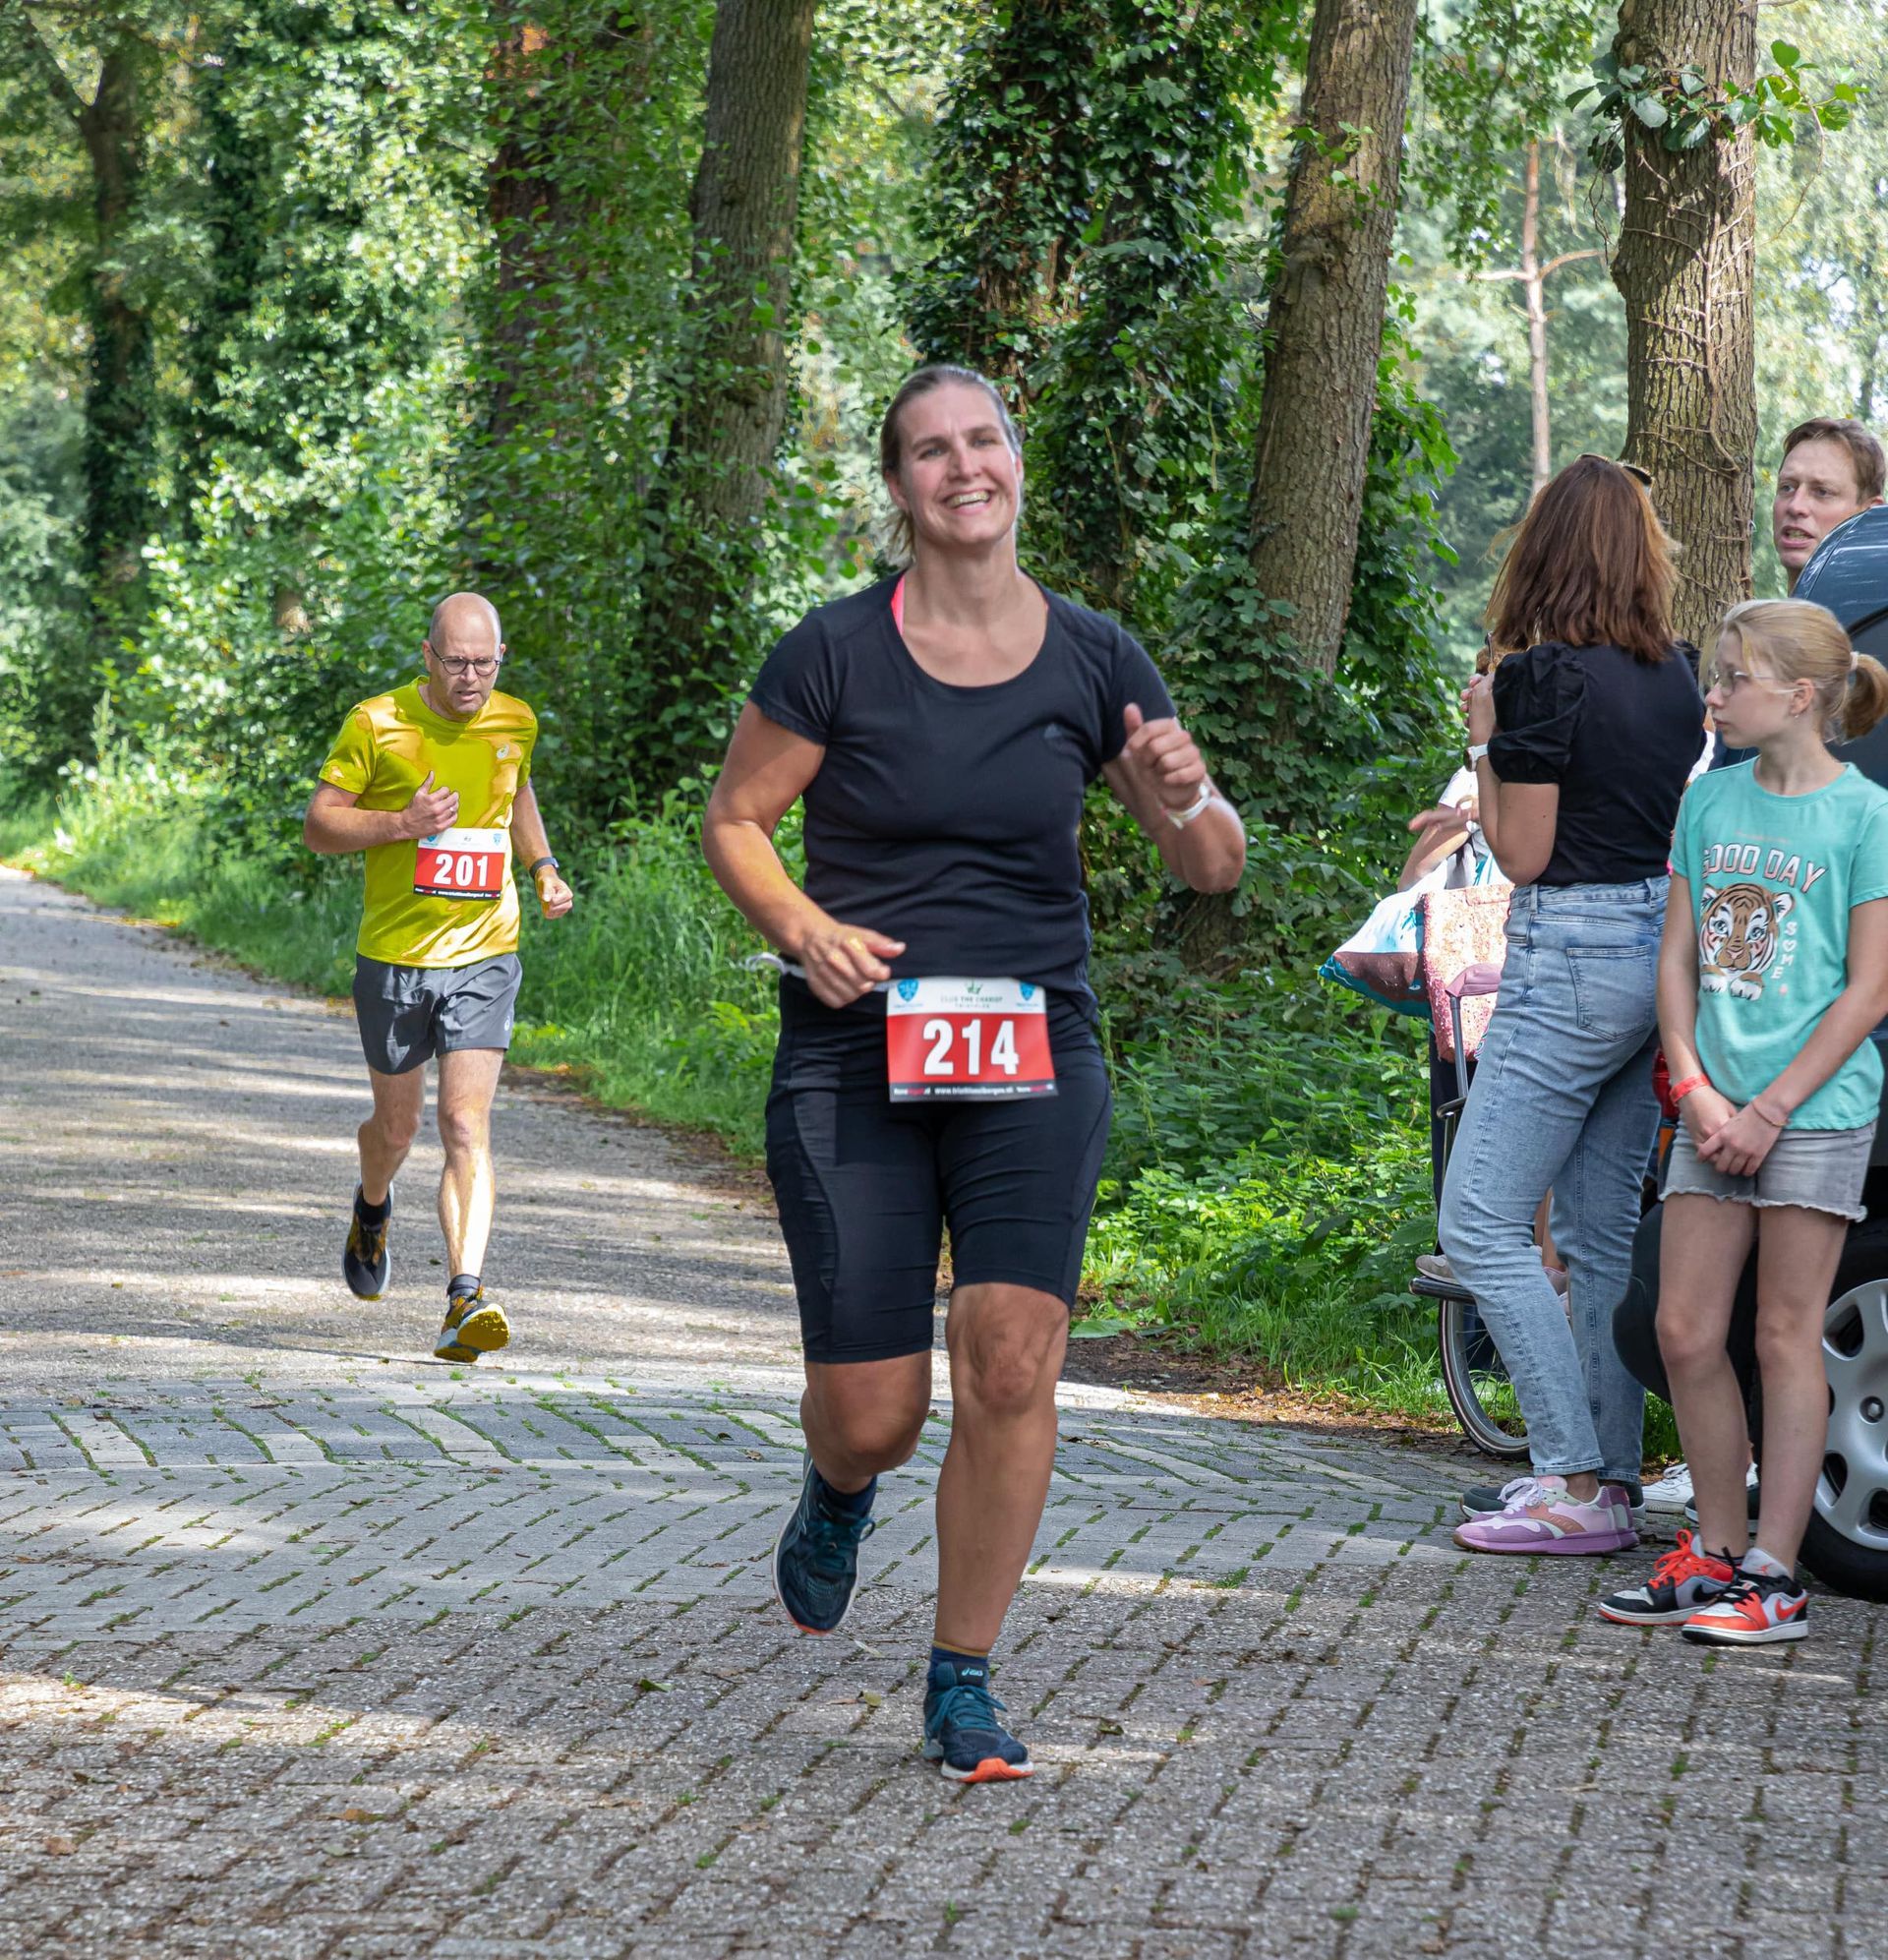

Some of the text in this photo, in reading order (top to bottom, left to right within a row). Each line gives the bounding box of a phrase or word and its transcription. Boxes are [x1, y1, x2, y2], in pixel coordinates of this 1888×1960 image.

[434, 853, 488, 887] 201
[1764, 849, 1826, 893] DAY
[923, 1019, 1020, 1075] 214
